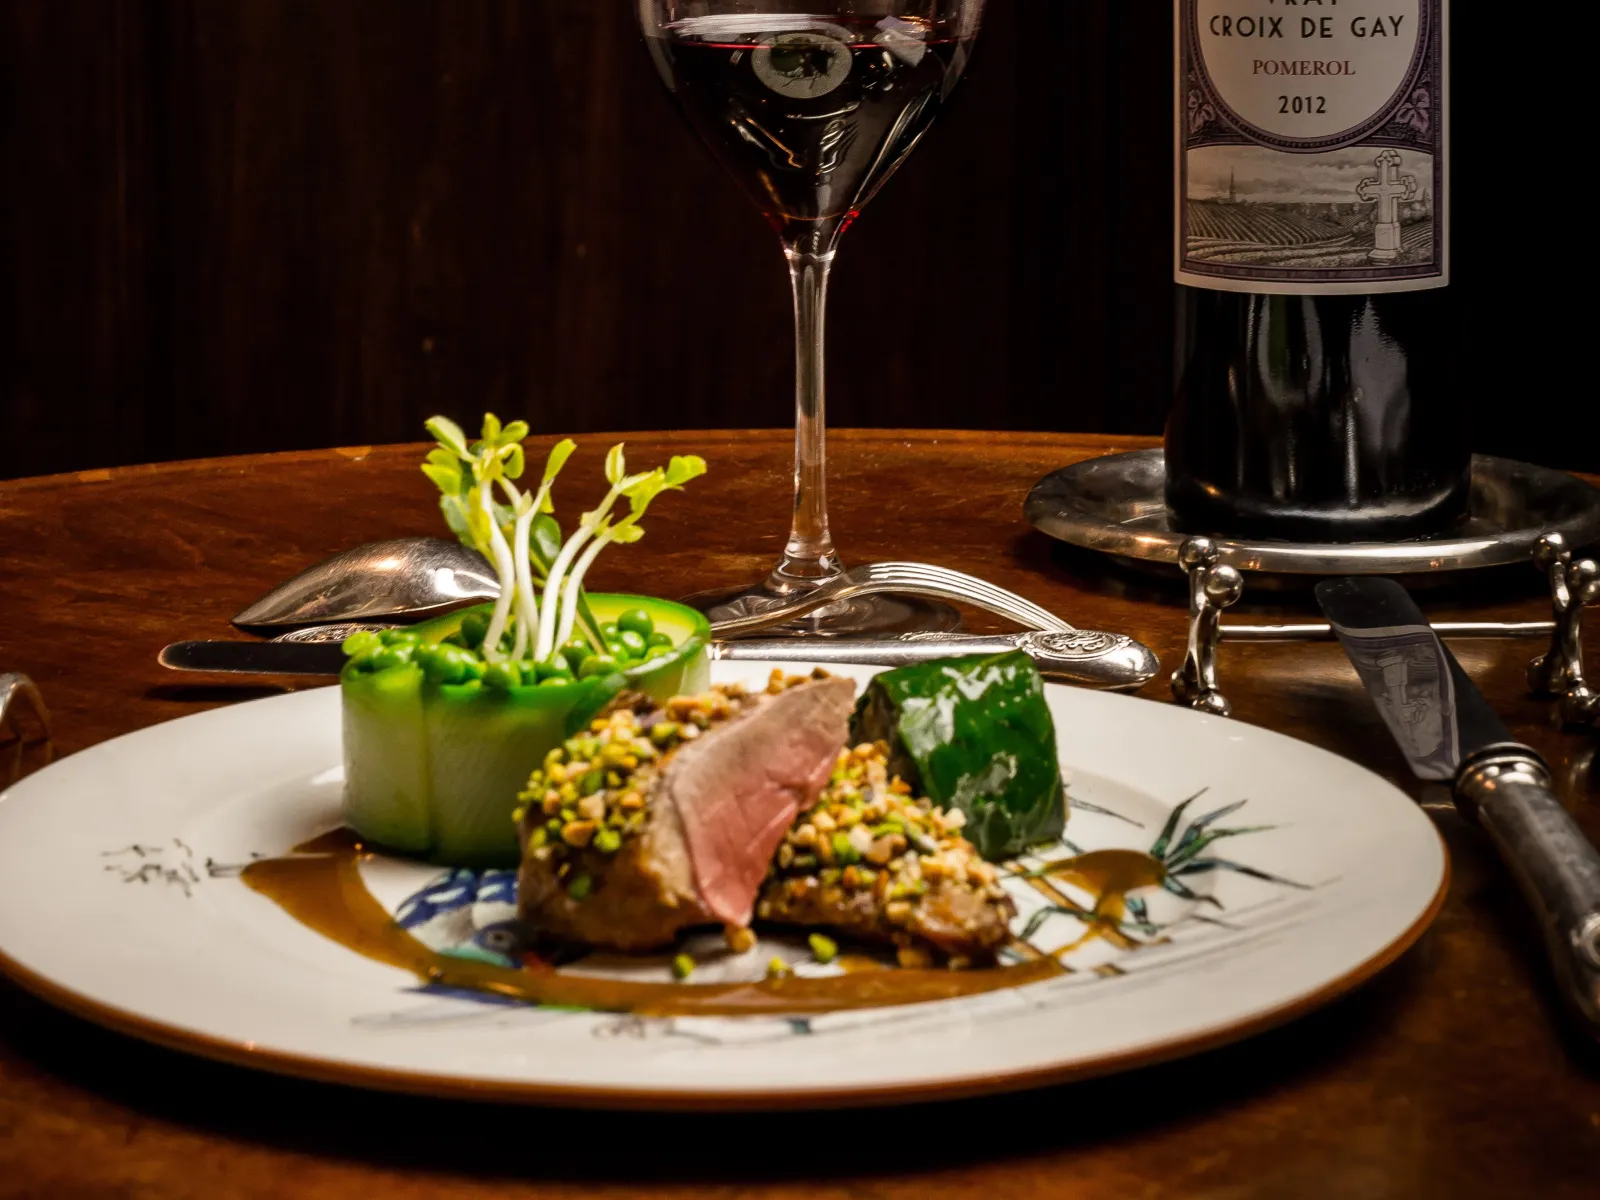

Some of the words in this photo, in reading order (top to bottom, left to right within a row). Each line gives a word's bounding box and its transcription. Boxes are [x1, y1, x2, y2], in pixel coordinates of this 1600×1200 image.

[1210, 15, 1284, 39] CROIX
[1301, 16, 1334, 39] DE
[1351, 14, 1405, 38] GAY
[1252, 59, 1356, 76] POMEROL
[1278, 95, 1327, 114] 2012
